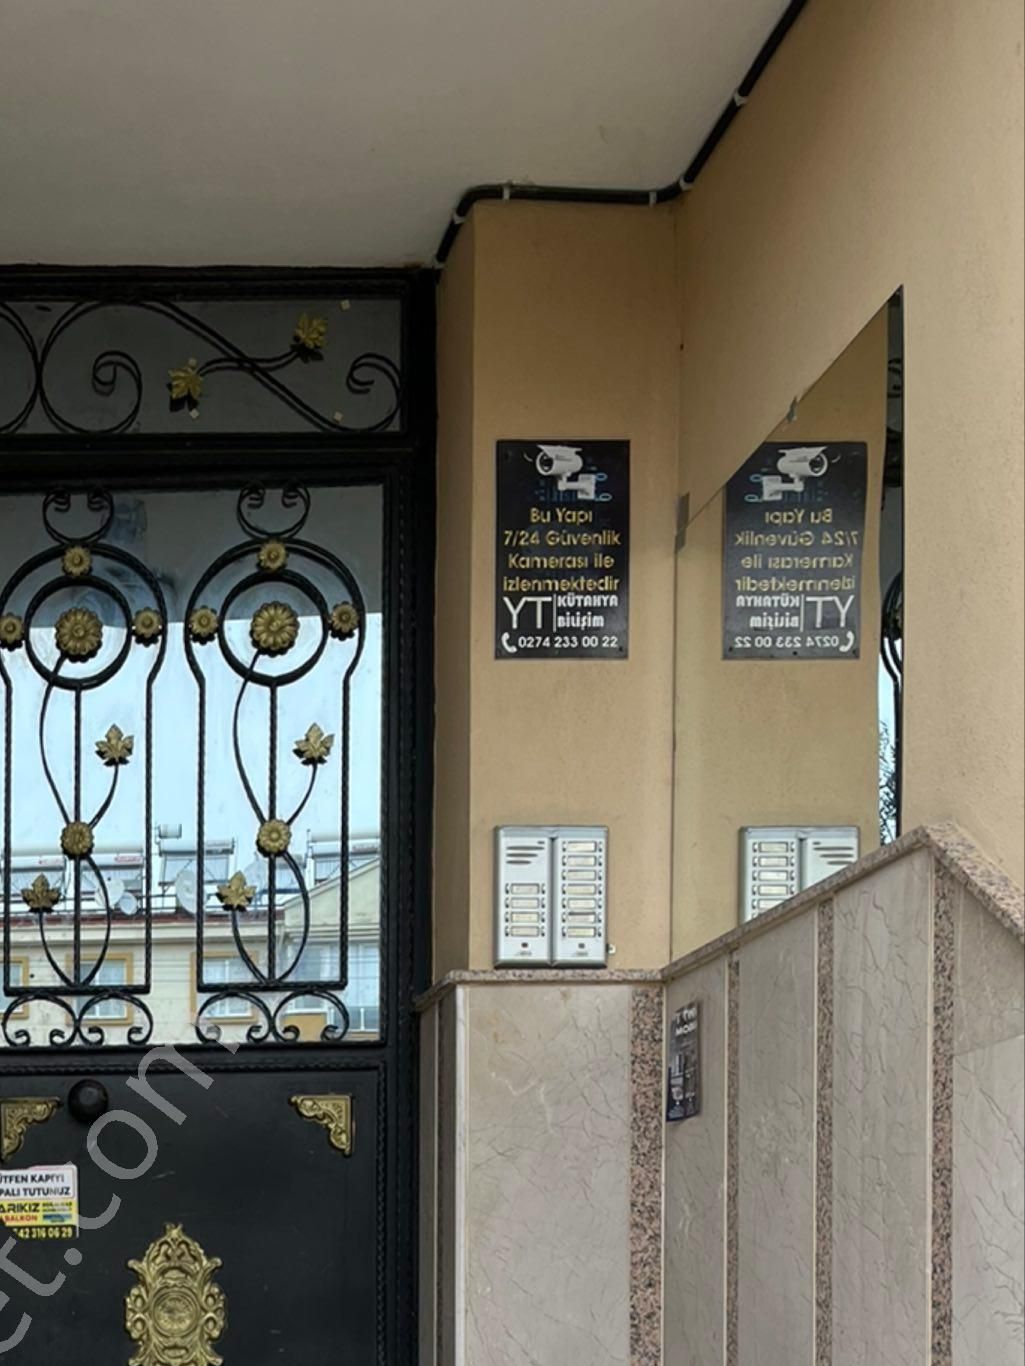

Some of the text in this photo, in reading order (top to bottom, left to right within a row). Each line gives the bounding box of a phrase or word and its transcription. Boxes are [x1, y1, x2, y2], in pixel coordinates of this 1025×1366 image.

[530, 507, 593, 526] Bu Yapı
[503, 530, 622, 547] 7/24 Güvenlik
[508, 553, 615, 569] Kamerası ile
[503, 576, 620, 592] izlenmektedir
[557, 592, 619, 608] KÜTAHYA
[503, 596, 553, 630] YT
[517, 636, 619, 648] 0274 233 00 22
[22, 1186, 71, 1197] TUTUNUZ
